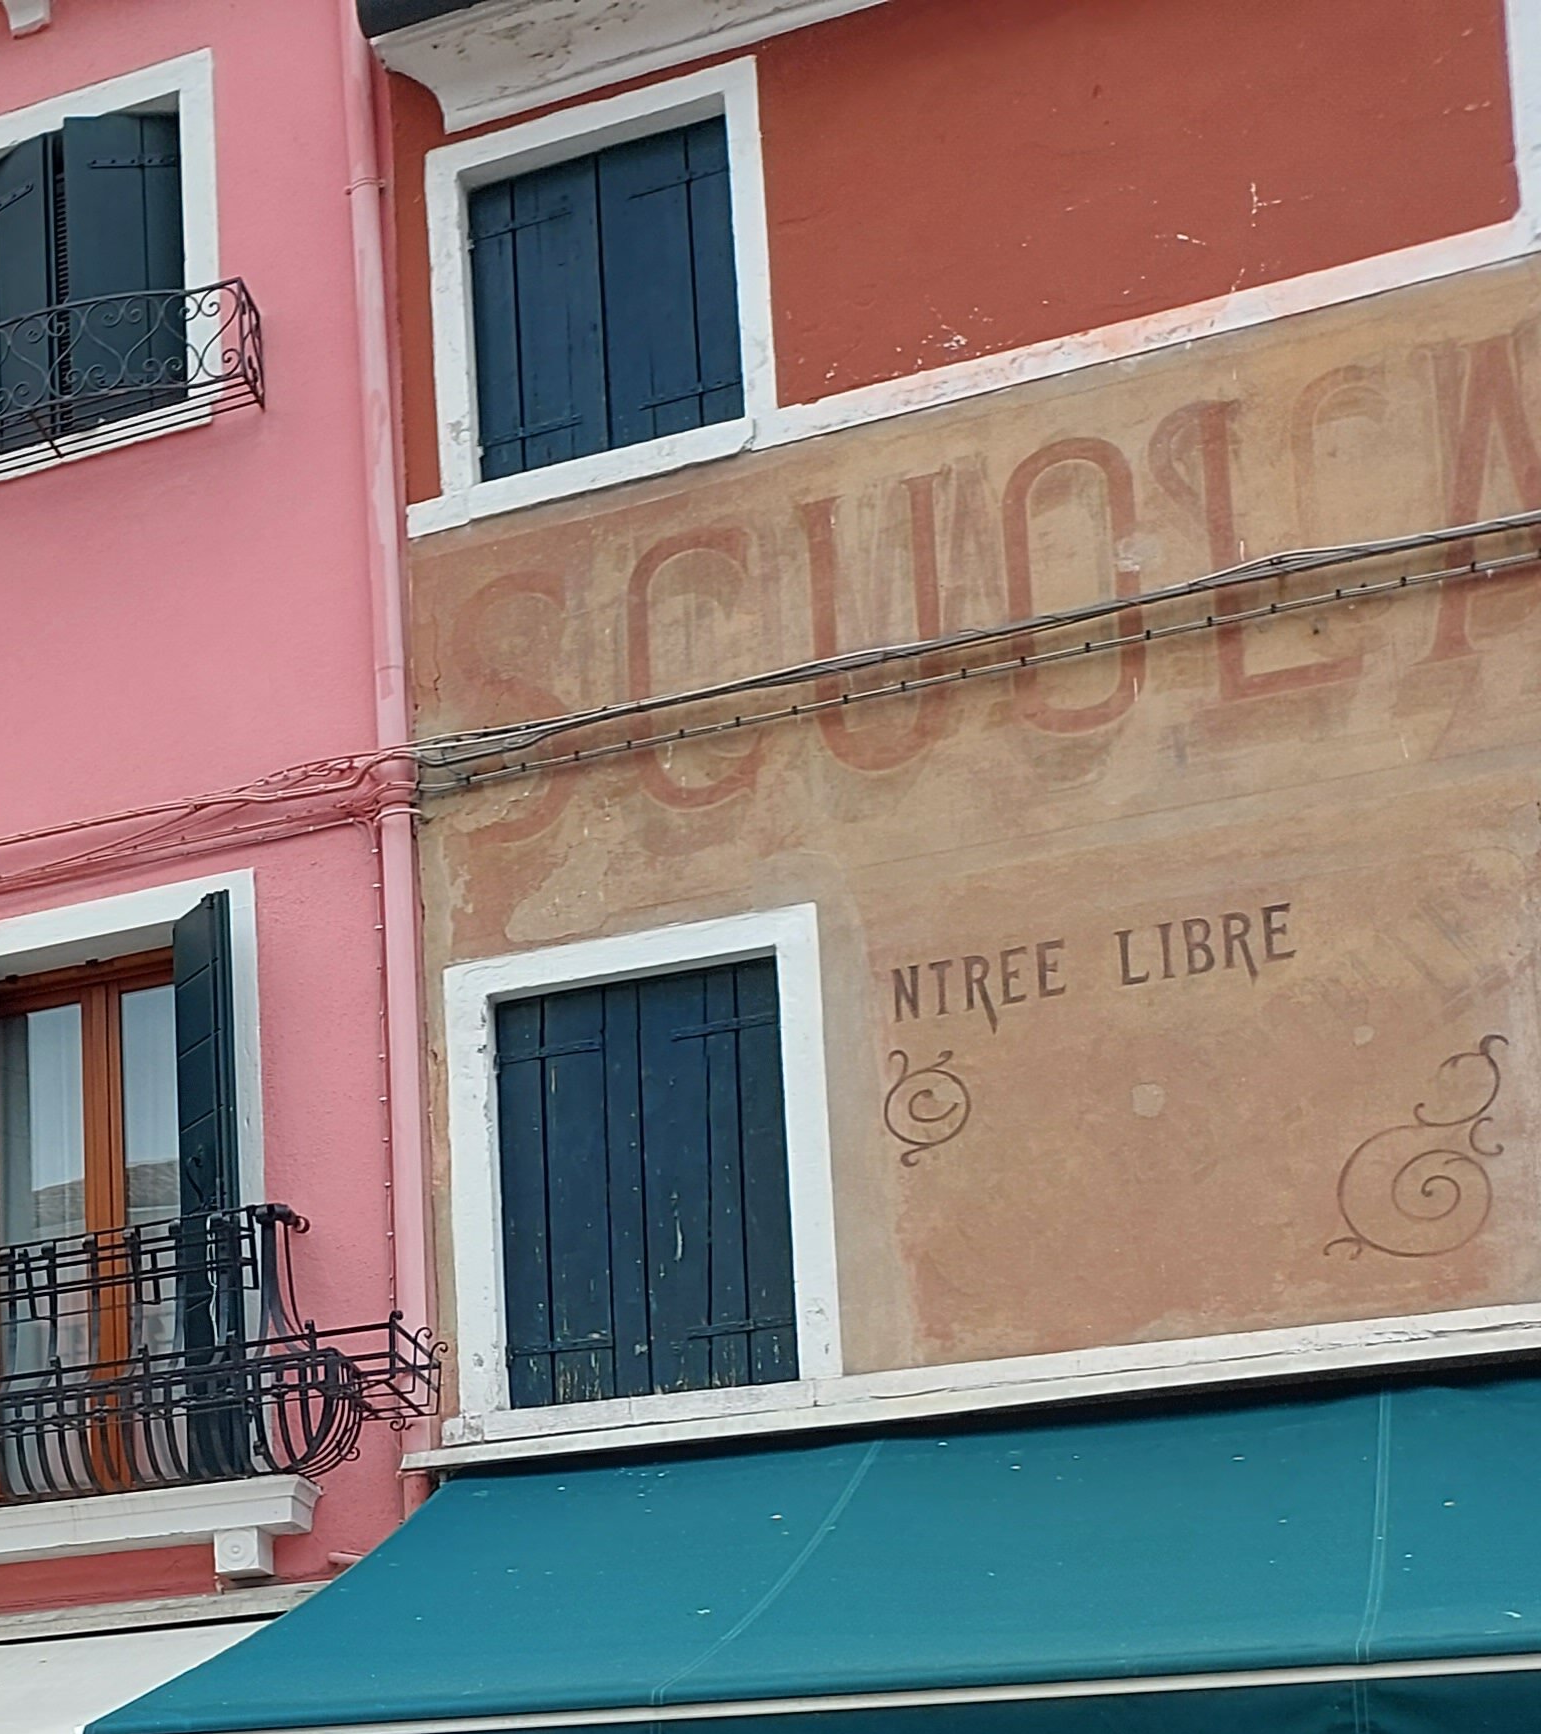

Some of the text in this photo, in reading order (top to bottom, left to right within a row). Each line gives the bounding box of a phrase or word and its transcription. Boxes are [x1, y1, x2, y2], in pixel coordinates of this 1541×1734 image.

[445, 332, 1541, 852] SCUOLA
[890, 902, 1297, 1035] NTREE LIBRE
